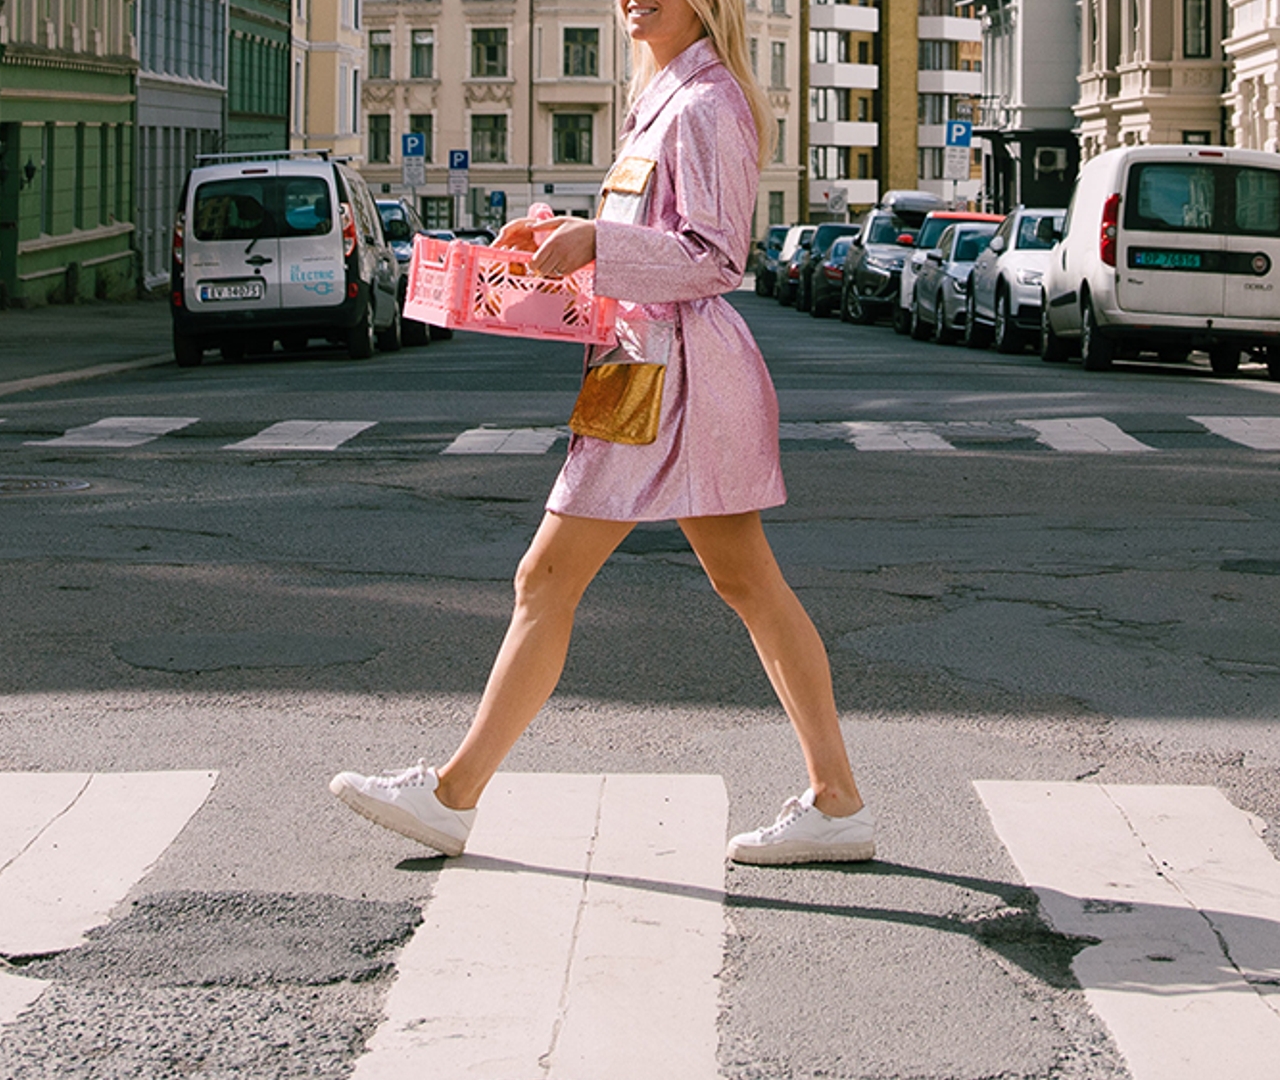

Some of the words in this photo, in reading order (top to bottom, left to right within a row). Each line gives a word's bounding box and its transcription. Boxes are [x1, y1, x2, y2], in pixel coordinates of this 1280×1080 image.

[951, 123, 967, 144] P
[406, 136, 420, 154] P
[453, 151, 465, 168] P
[290, 269, 335, 282] ELECTRIC
